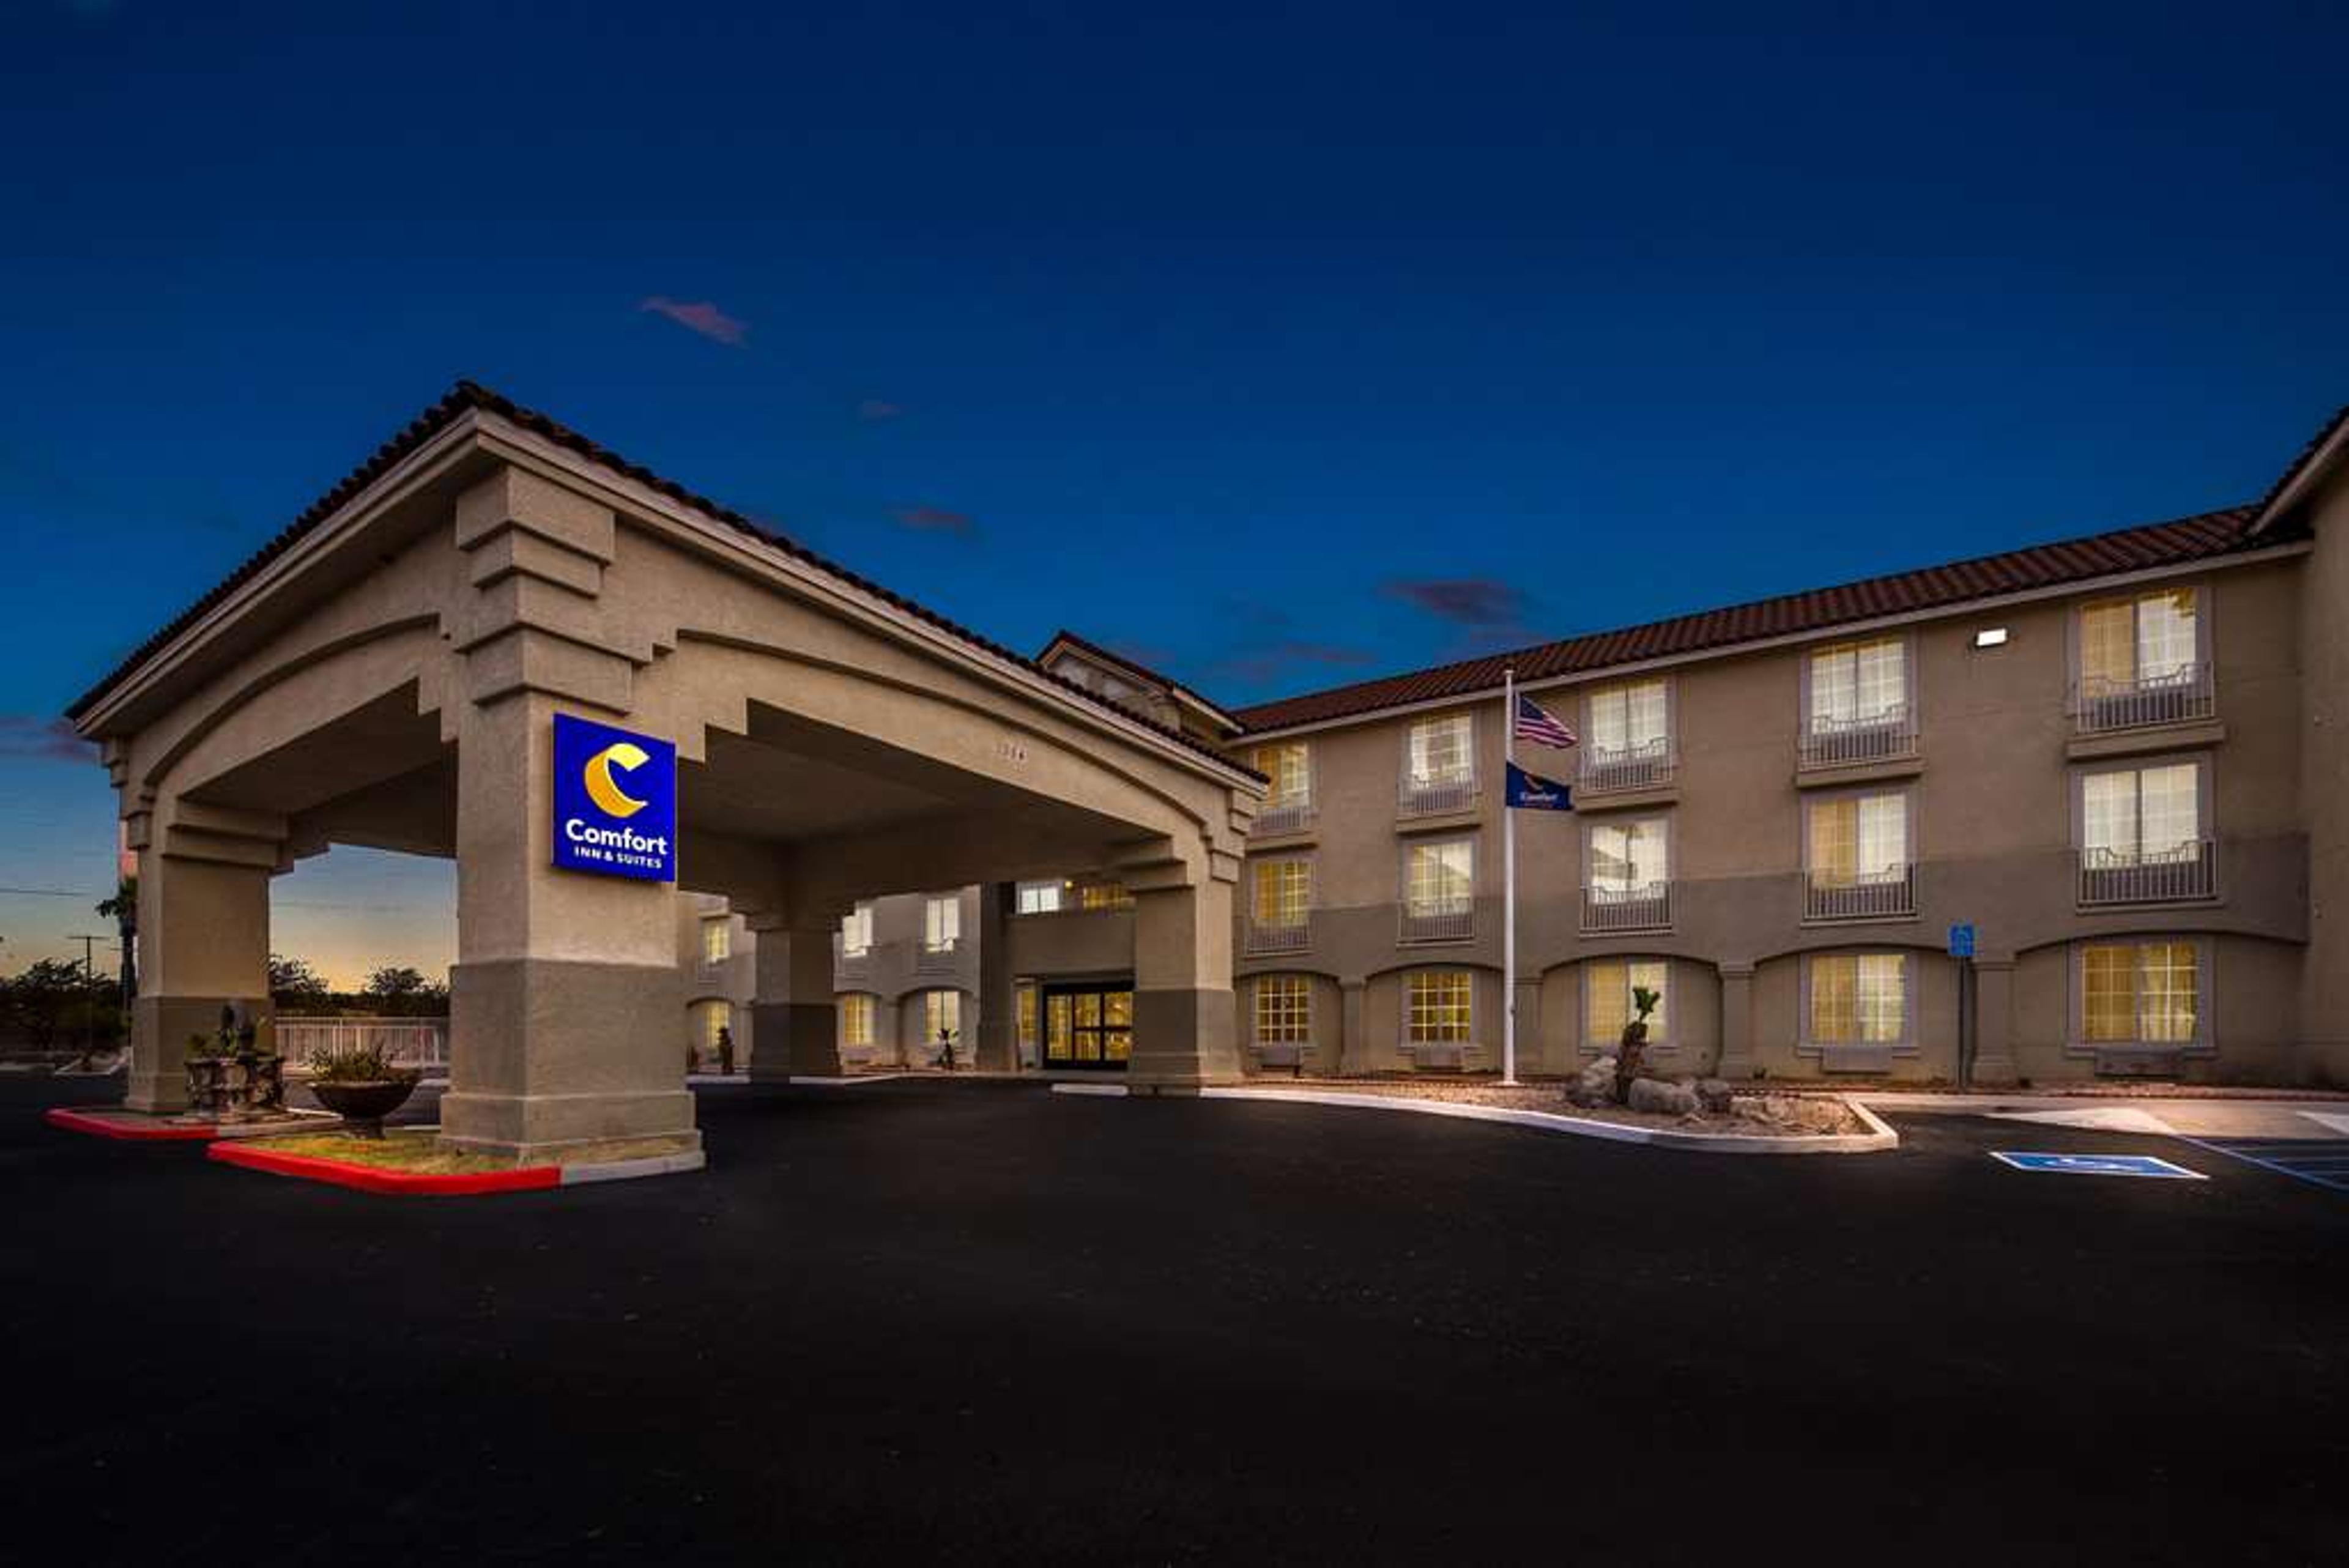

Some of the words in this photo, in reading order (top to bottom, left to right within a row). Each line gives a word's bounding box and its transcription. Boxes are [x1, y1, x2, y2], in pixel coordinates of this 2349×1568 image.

[566, 819, 667, 855] Comfort
[574, 845, 601, 860] INN
[604, 850, 614, 861] &
[617, 852, 662, 869] SUITES
